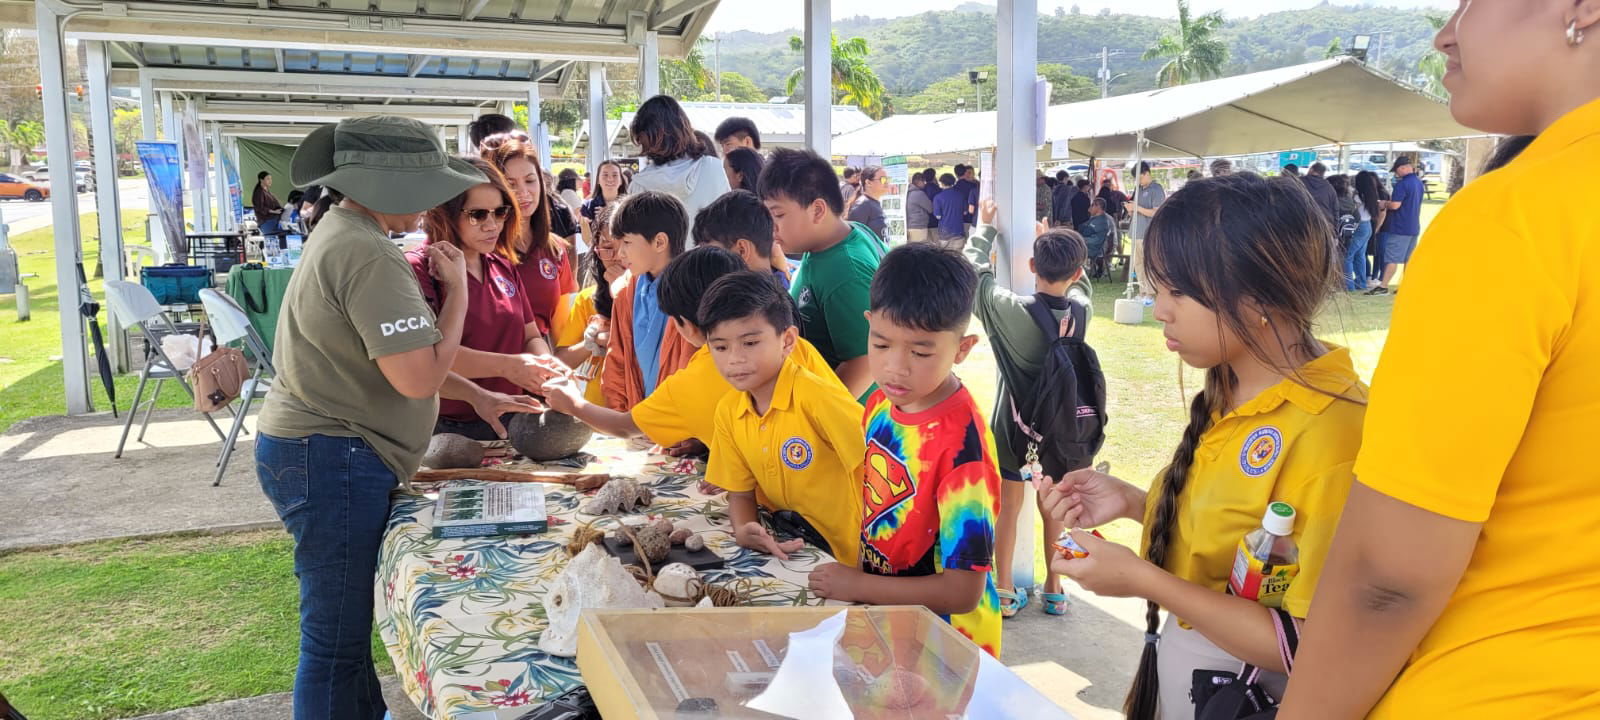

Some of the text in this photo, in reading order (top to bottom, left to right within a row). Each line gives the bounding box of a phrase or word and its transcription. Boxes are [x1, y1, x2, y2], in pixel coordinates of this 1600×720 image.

[380, 316, 431, 337] DCCA
[1268, 576, 1287, 584] Black
[1262, 582, 1290, 594] Tea
